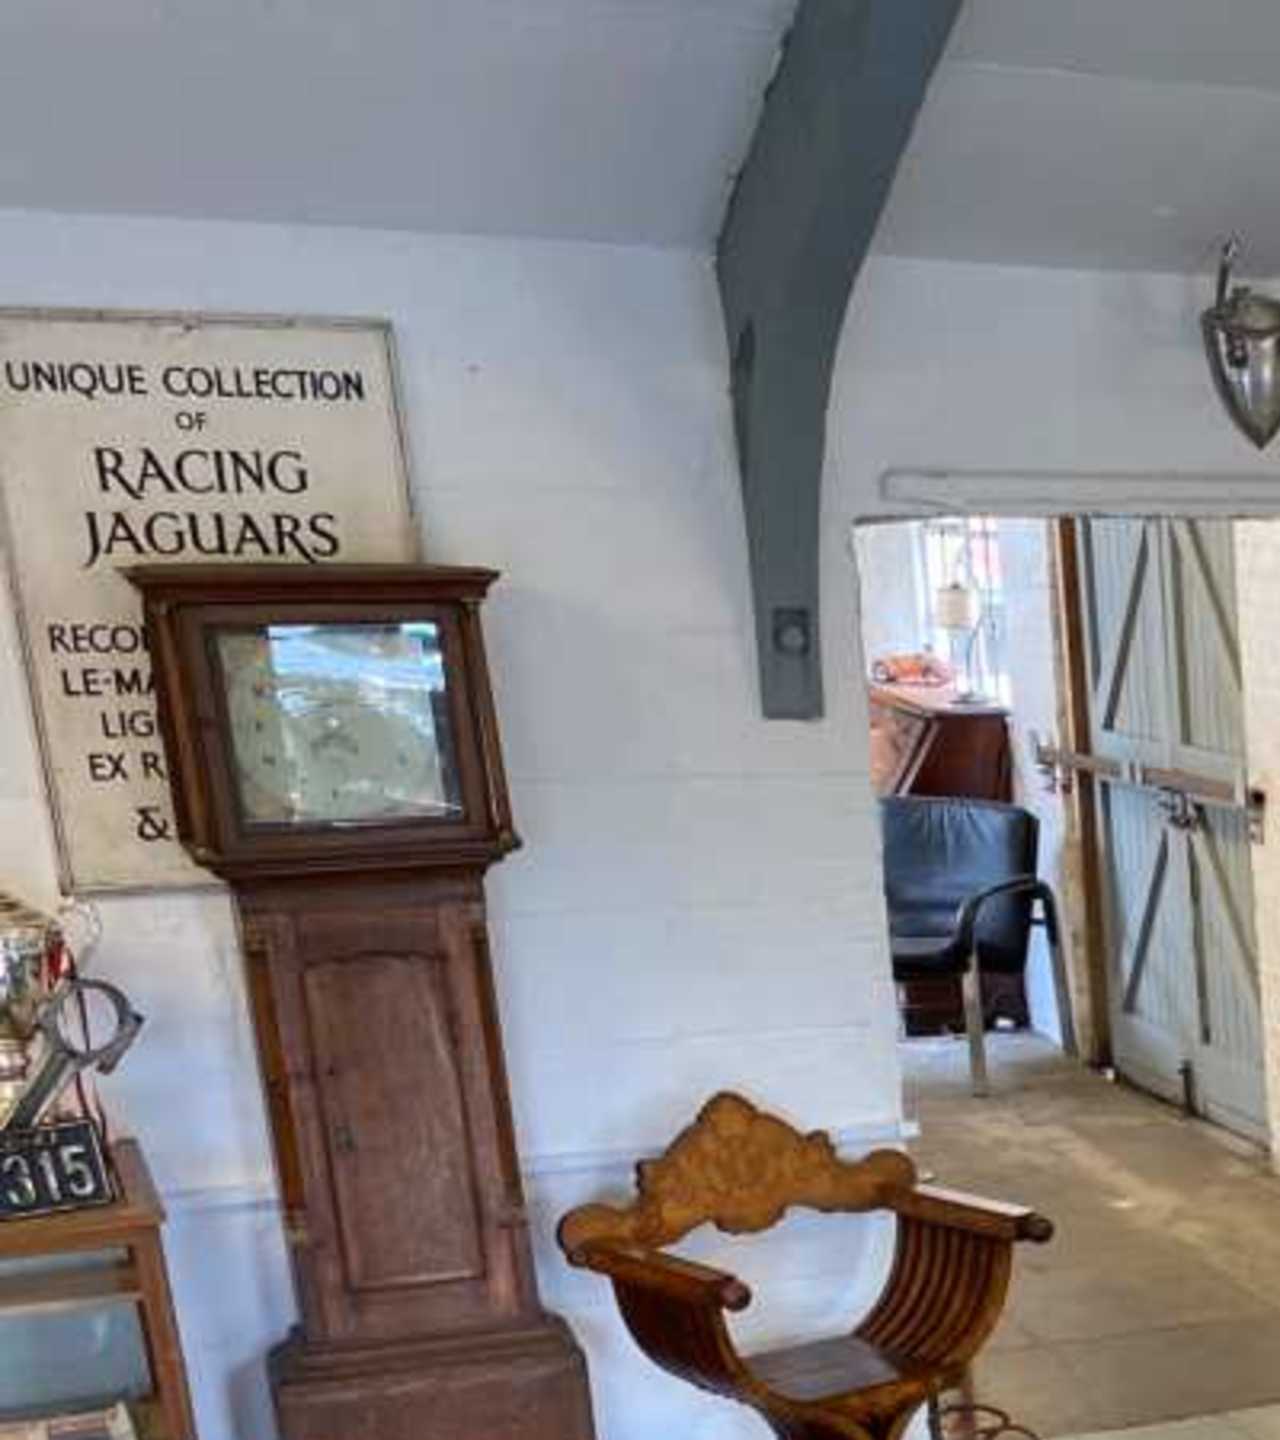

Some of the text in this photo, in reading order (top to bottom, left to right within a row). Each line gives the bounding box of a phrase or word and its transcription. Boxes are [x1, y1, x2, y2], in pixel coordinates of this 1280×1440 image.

[5, 361, 365, 400] UNIQUE COLLECTION
[176, 412, 206, 431] OF
[94, 447, 309, 499] RACING
[83, 512, 340, 565] JAGUARS
[88, 753, 128, 781] EX
[136, 807, 170, 841] &
